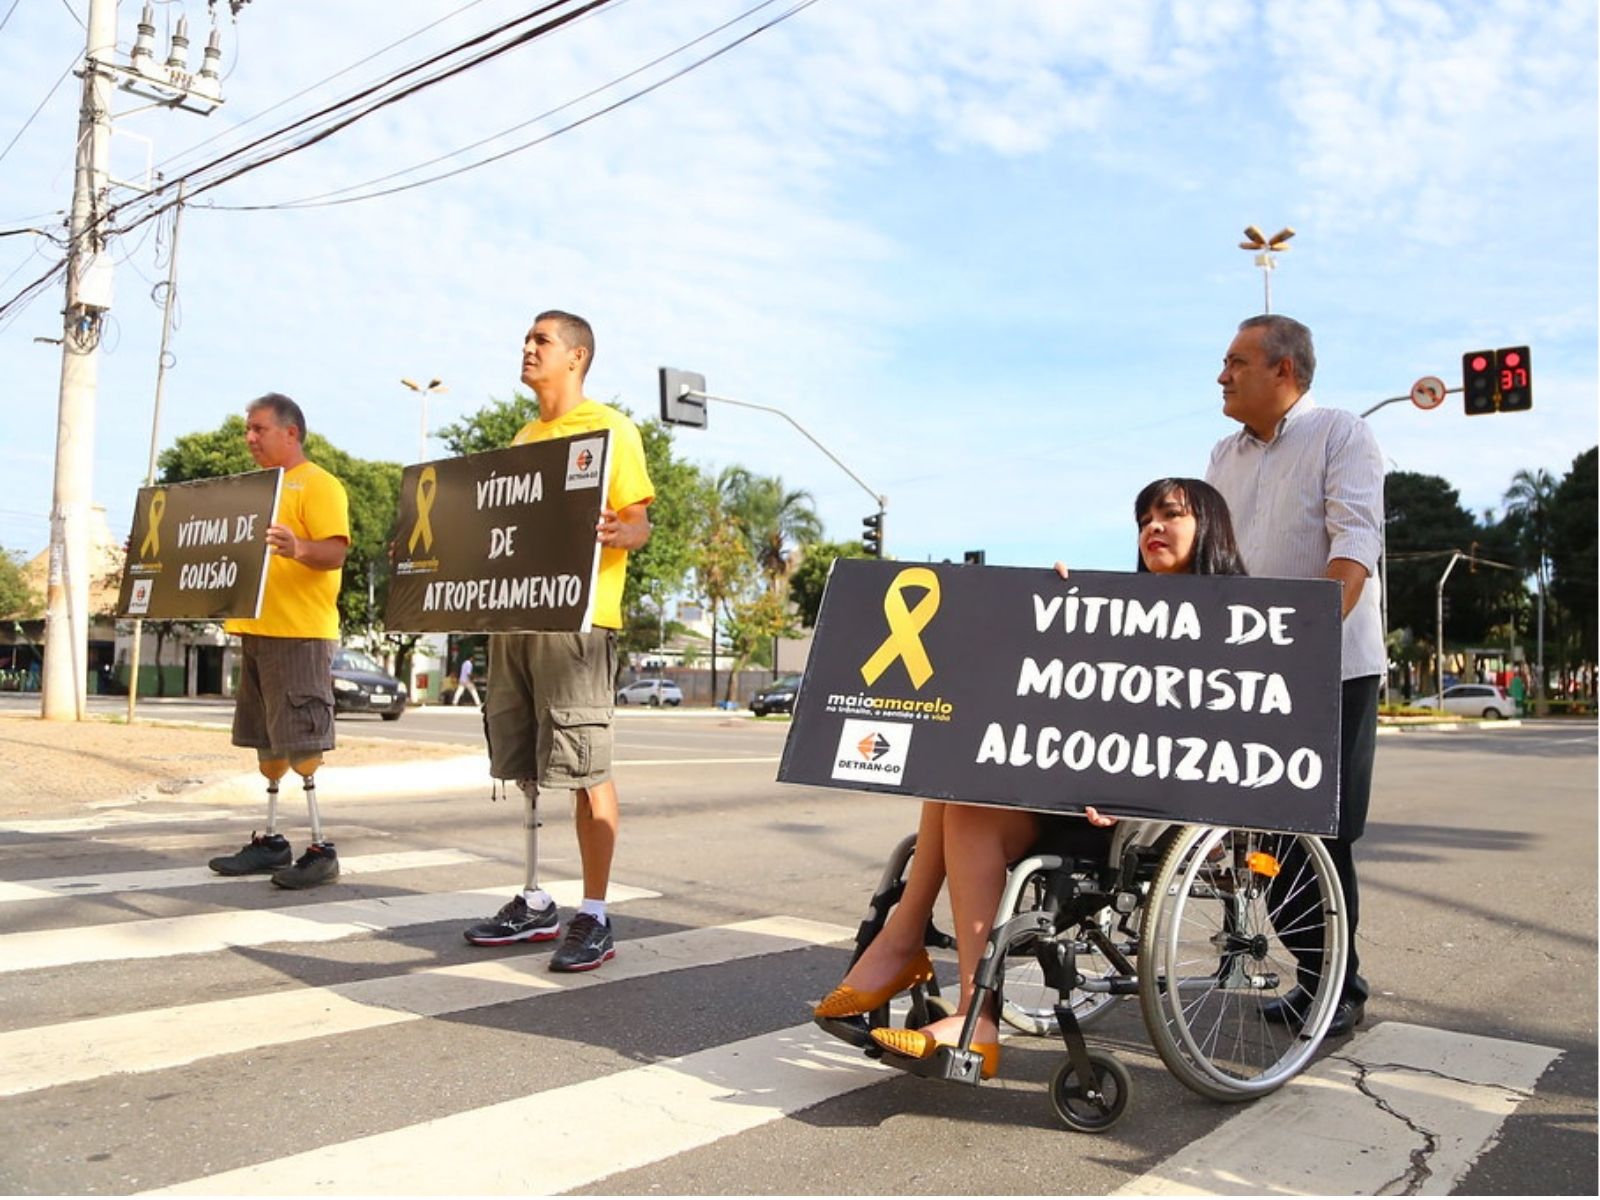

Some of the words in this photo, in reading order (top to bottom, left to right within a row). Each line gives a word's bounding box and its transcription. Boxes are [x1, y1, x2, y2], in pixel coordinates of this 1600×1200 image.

[1501, 368, 1527, 390] 37
[476, 470, 544, 511] VÍTIMA
[177, 514, 229, 548] VÍTIMA
[233, 513, 259, 544] DE
[488, 526, 517, 560] DE
[179, 556, 238, 591] COLISÃO
[422, 574, 583, 612] ATROPELAMENTO
[1032, 586, 1202, 640] VÍTIMA
[1224, 603, 1297, 646] DE
[1016, 656, 1293, 715] MOTORISTA
[838, 759, 901, 774] DETRAN-GO
[975, 722, 1323, 790] ALCOOLIZADO
